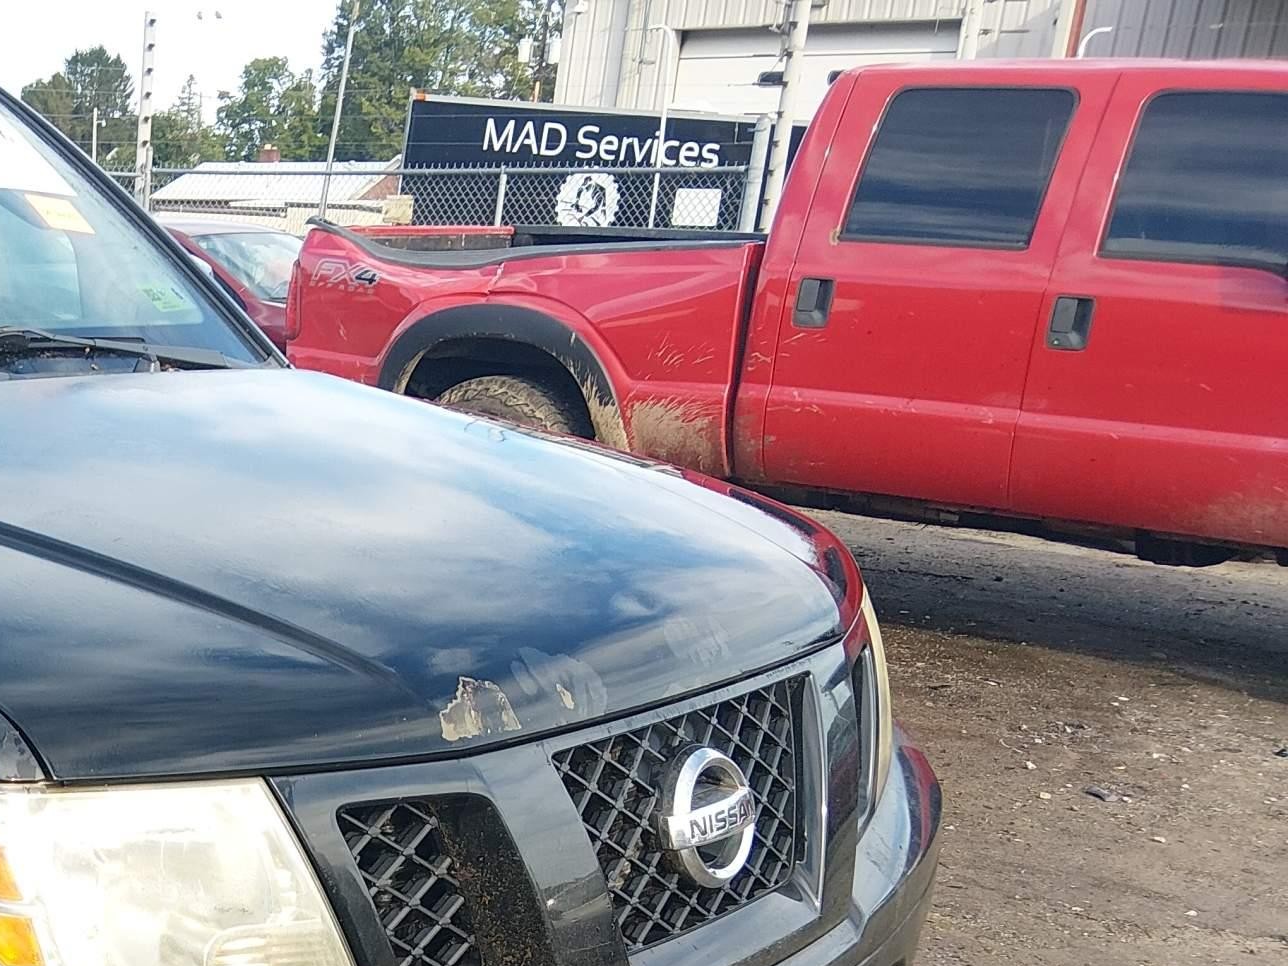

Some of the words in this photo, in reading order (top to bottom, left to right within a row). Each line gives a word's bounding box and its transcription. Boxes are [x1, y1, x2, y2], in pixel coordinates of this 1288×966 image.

[482, 117, 568, 157] MAD
[575, 124, 721, 169] Services
[310, 258, 383, 287] FX4
[688, 799, 756, 841] NISSAN
